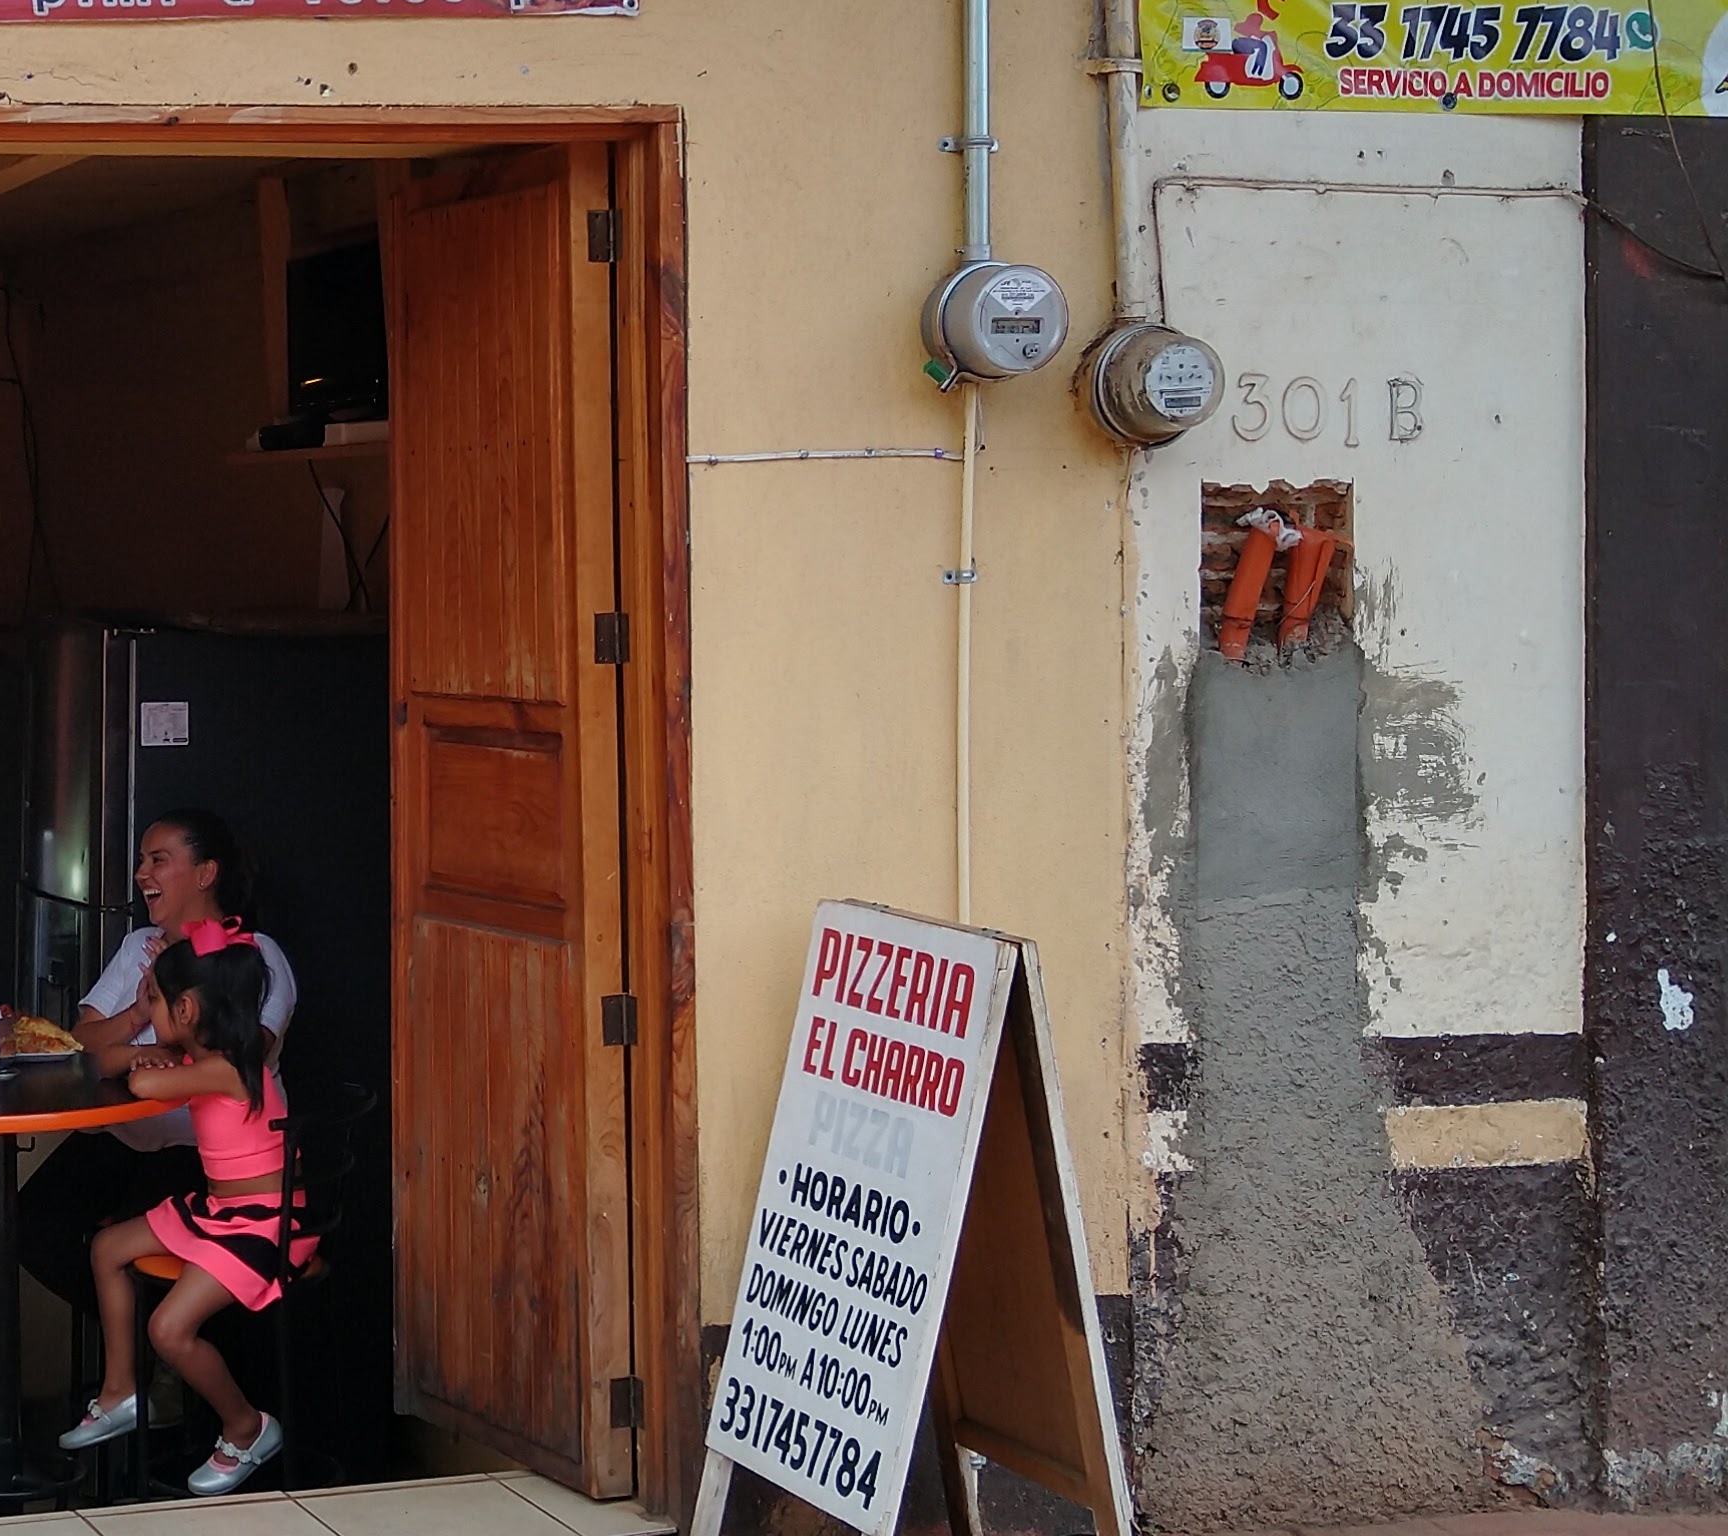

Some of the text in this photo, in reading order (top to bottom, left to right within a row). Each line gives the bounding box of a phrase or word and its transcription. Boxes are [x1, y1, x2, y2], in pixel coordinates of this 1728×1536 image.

[1324, 4, 1621, 62] 33 1745 7784
[1339, 69, 1610, 99] SERVICIO A DOMICILIO
[1232, 372, 1425, 448] 301 B
[812, 927, 975, 1040] PIZZERIA
[802, 1015, 965, 1118] EL CHARRO
[808, 1090, 915, 1179] PIZZA
[759, 1208, 928, 1315] VIERNES SABADO
[746, 1263, 908, 1368] DOMINGO LUNES
[720, 1376, 883, 1510] 3317457784
